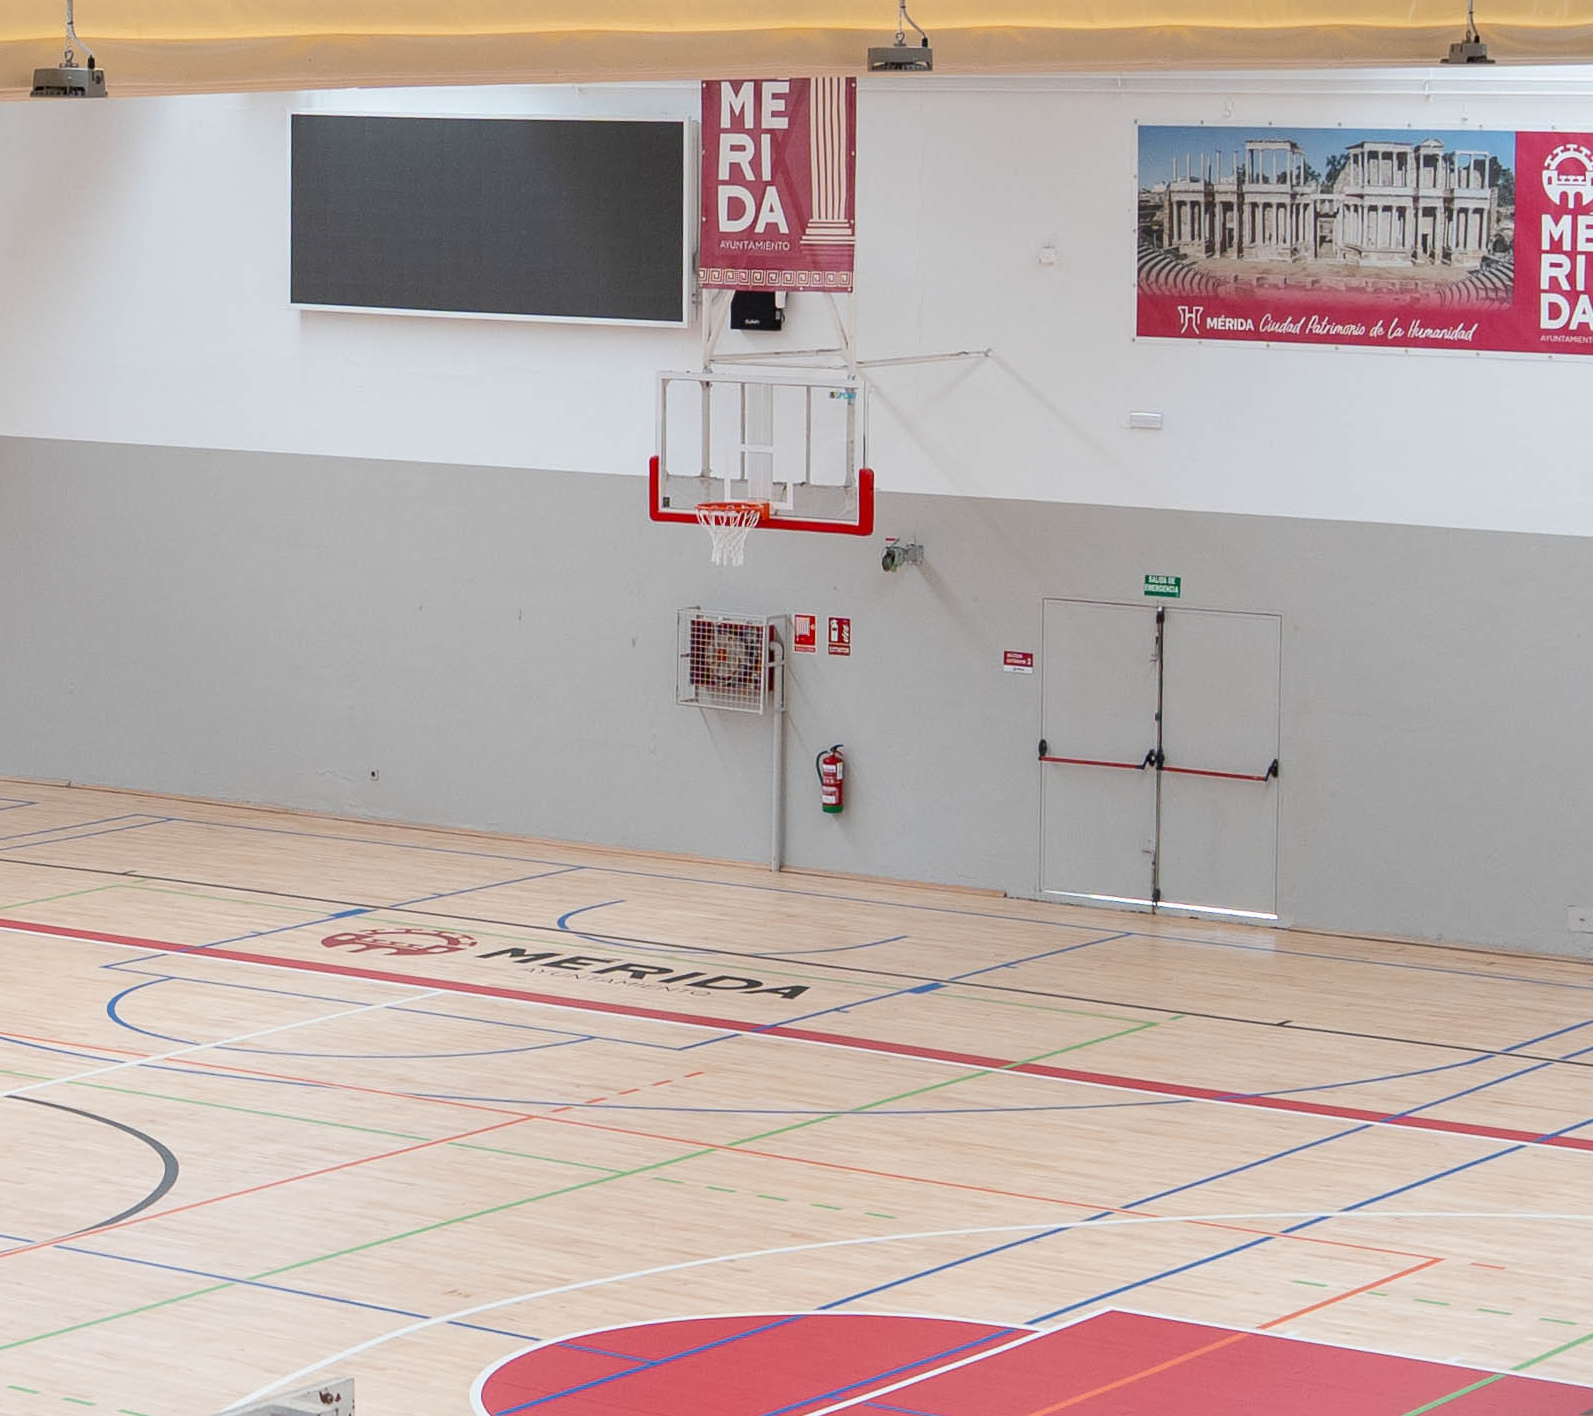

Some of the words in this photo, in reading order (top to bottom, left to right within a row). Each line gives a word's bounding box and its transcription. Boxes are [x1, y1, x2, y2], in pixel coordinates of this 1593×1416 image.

[718, 133, 772, 182] RI
[717, 185, 790, 234] DA
[720, 239, 790, 251] AYUNTAMIENTO
[1540, 253, 1587, 291] RI
[1206, 314, 1255, 331] MÉRIDA
[1259, 313, 1307, 334] Ciudad
[1306, 314, 1366, 336] Patrimonio
[1369, 319, 1385, 338] de
[1407, 319, 1479, 342] Humanidad
